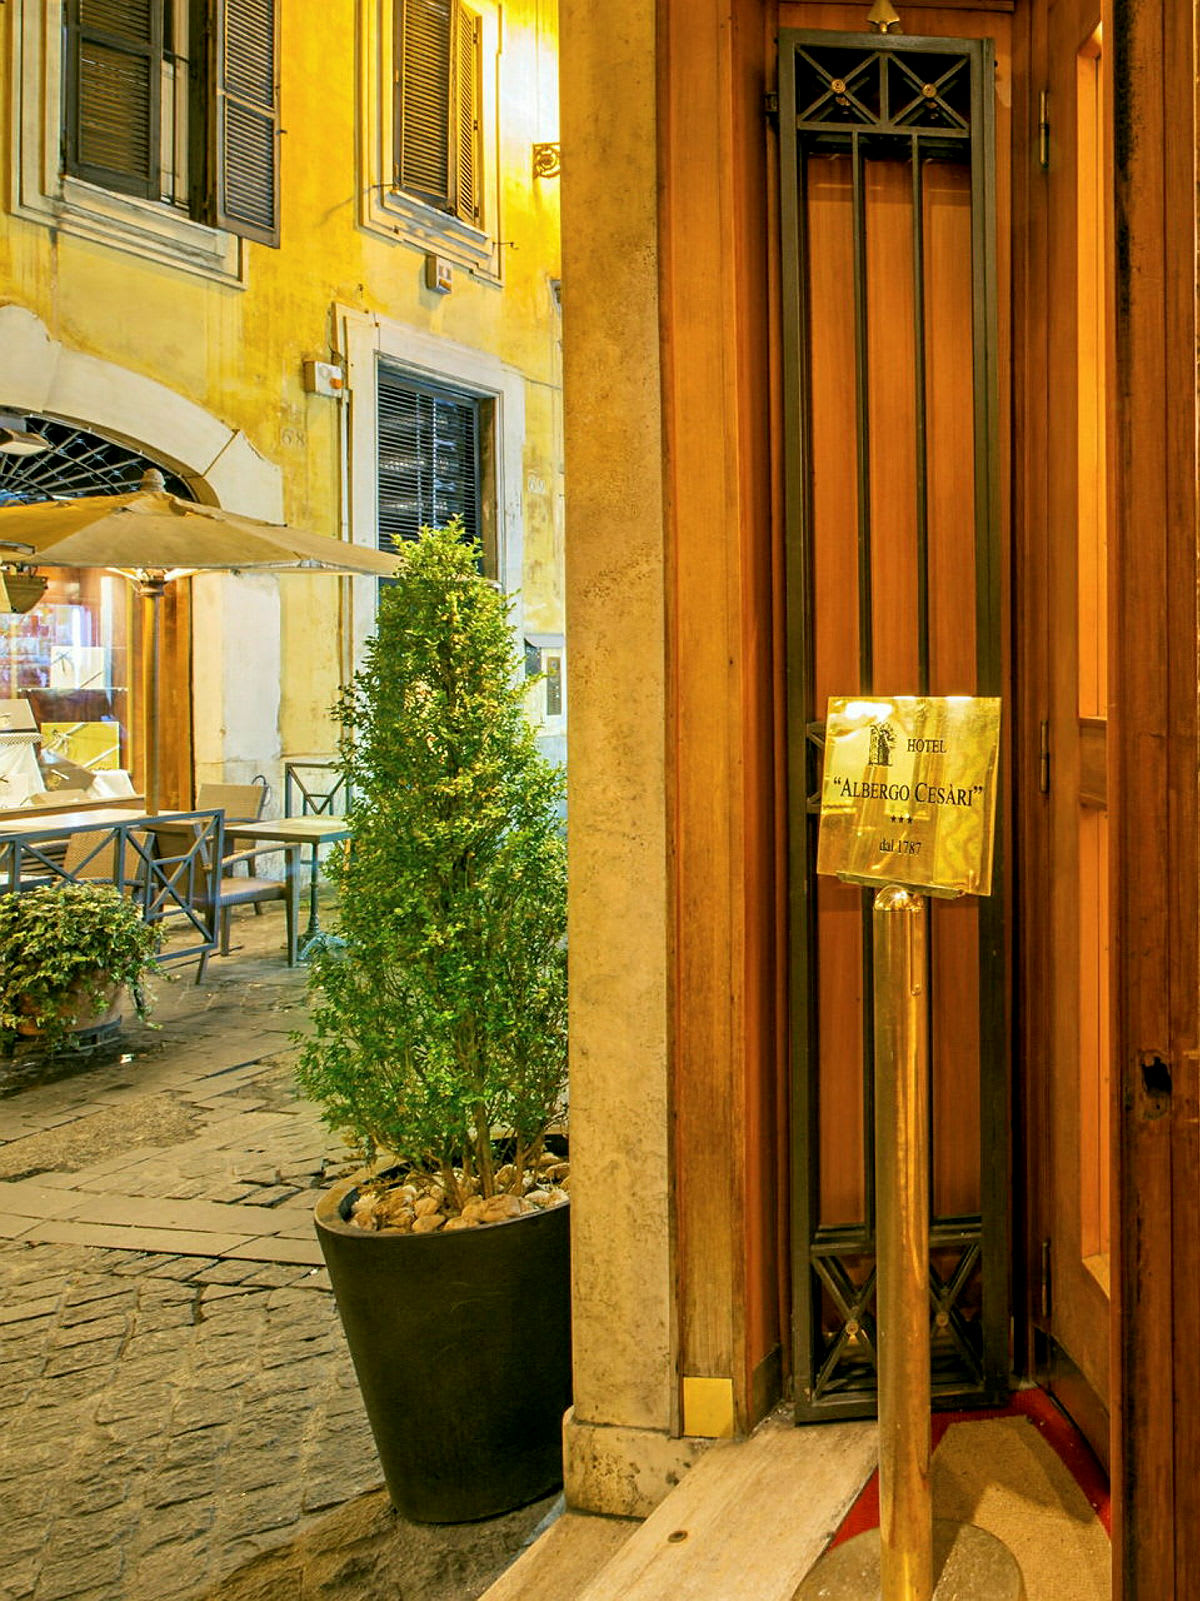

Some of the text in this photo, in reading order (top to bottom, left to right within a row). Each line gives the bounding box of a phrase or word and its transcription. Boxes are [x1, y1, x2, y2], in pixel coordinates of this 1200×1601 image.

[907, 739, 947, 753] HOTEL
[879, 837, 922, 855] dal 1787
